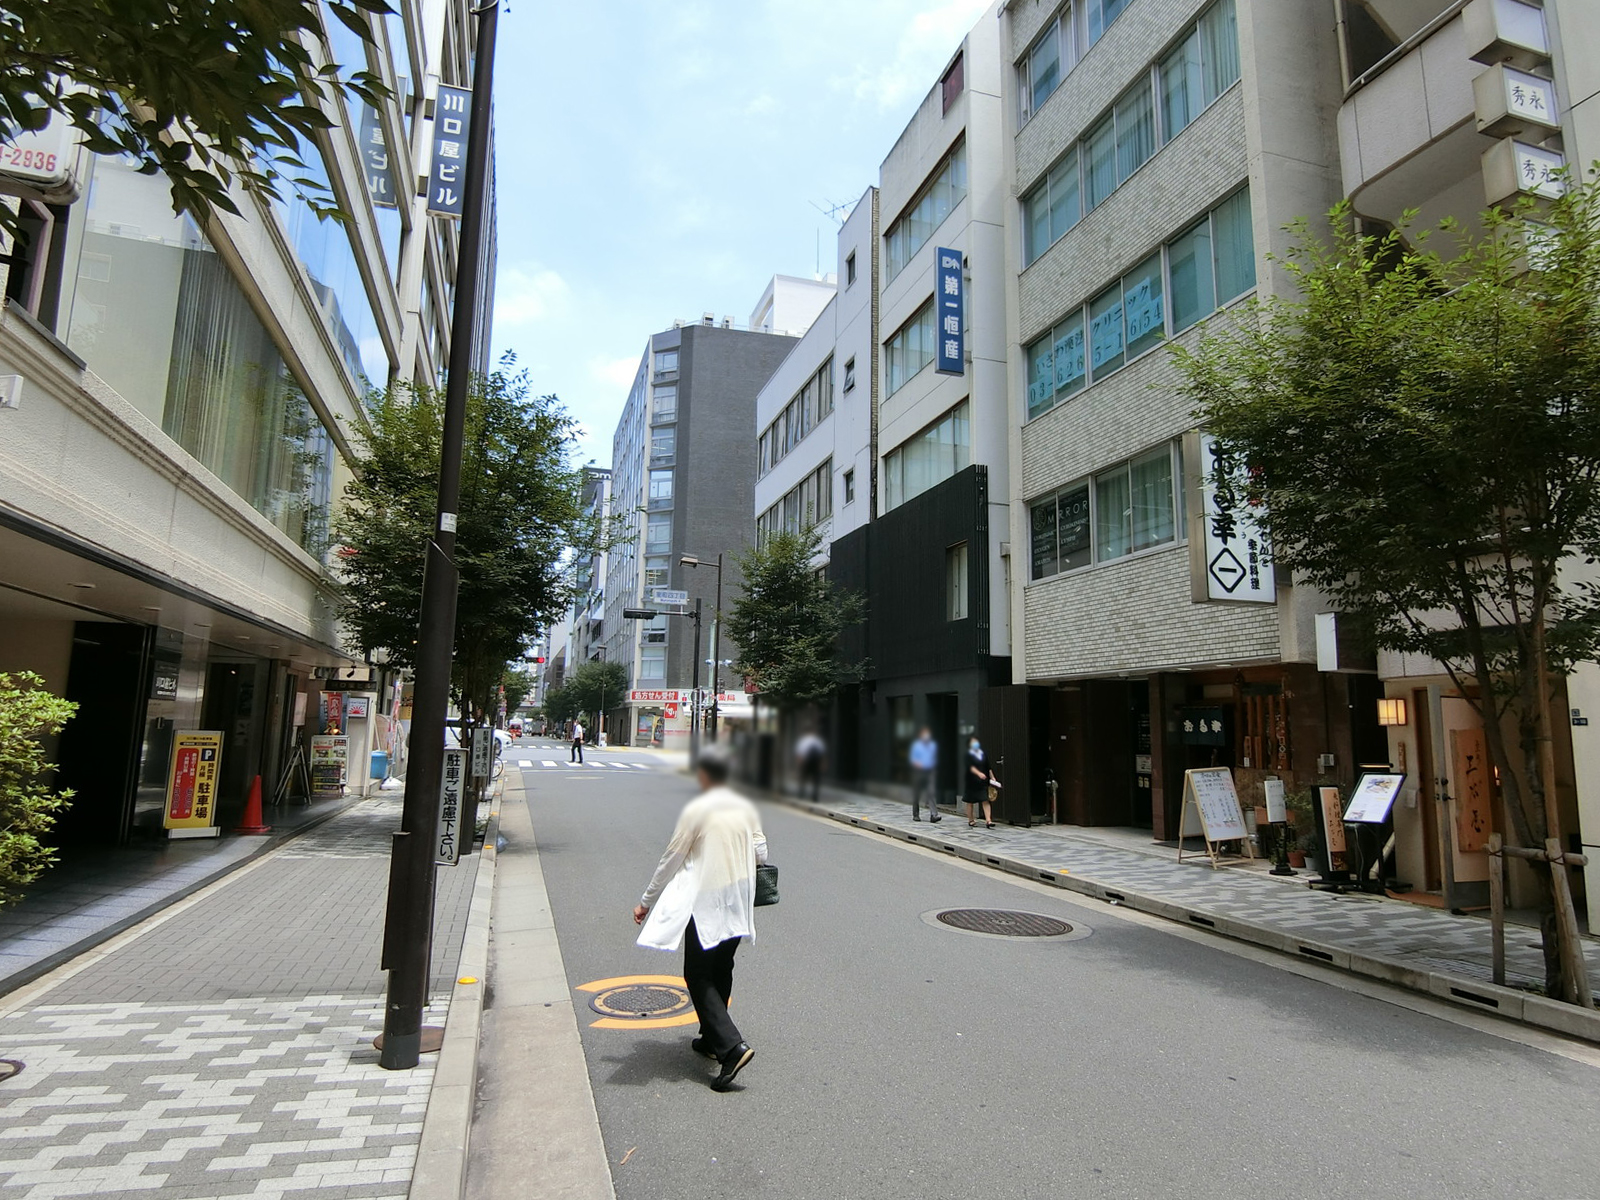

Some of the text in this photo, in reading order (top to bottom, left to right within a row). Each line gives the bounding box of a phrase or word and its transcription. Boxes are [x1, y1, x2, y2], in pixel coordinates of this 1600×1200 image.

[1511, 86, 1544, 110] 秀永
[437, 94, 464, 206] 川口屋ビル
[944, 275, 960, 359] 第一恒産
[1030, 302, 1161, 403] 03-6265-1654
[1047, 500, 1088, 524] MRROR
[634, 691, 676, 700] 処方せん受付
[195, 782, 211, 818] 駐車場
[440, 754, 461, 861] 駐車ご遠慮下さい。
